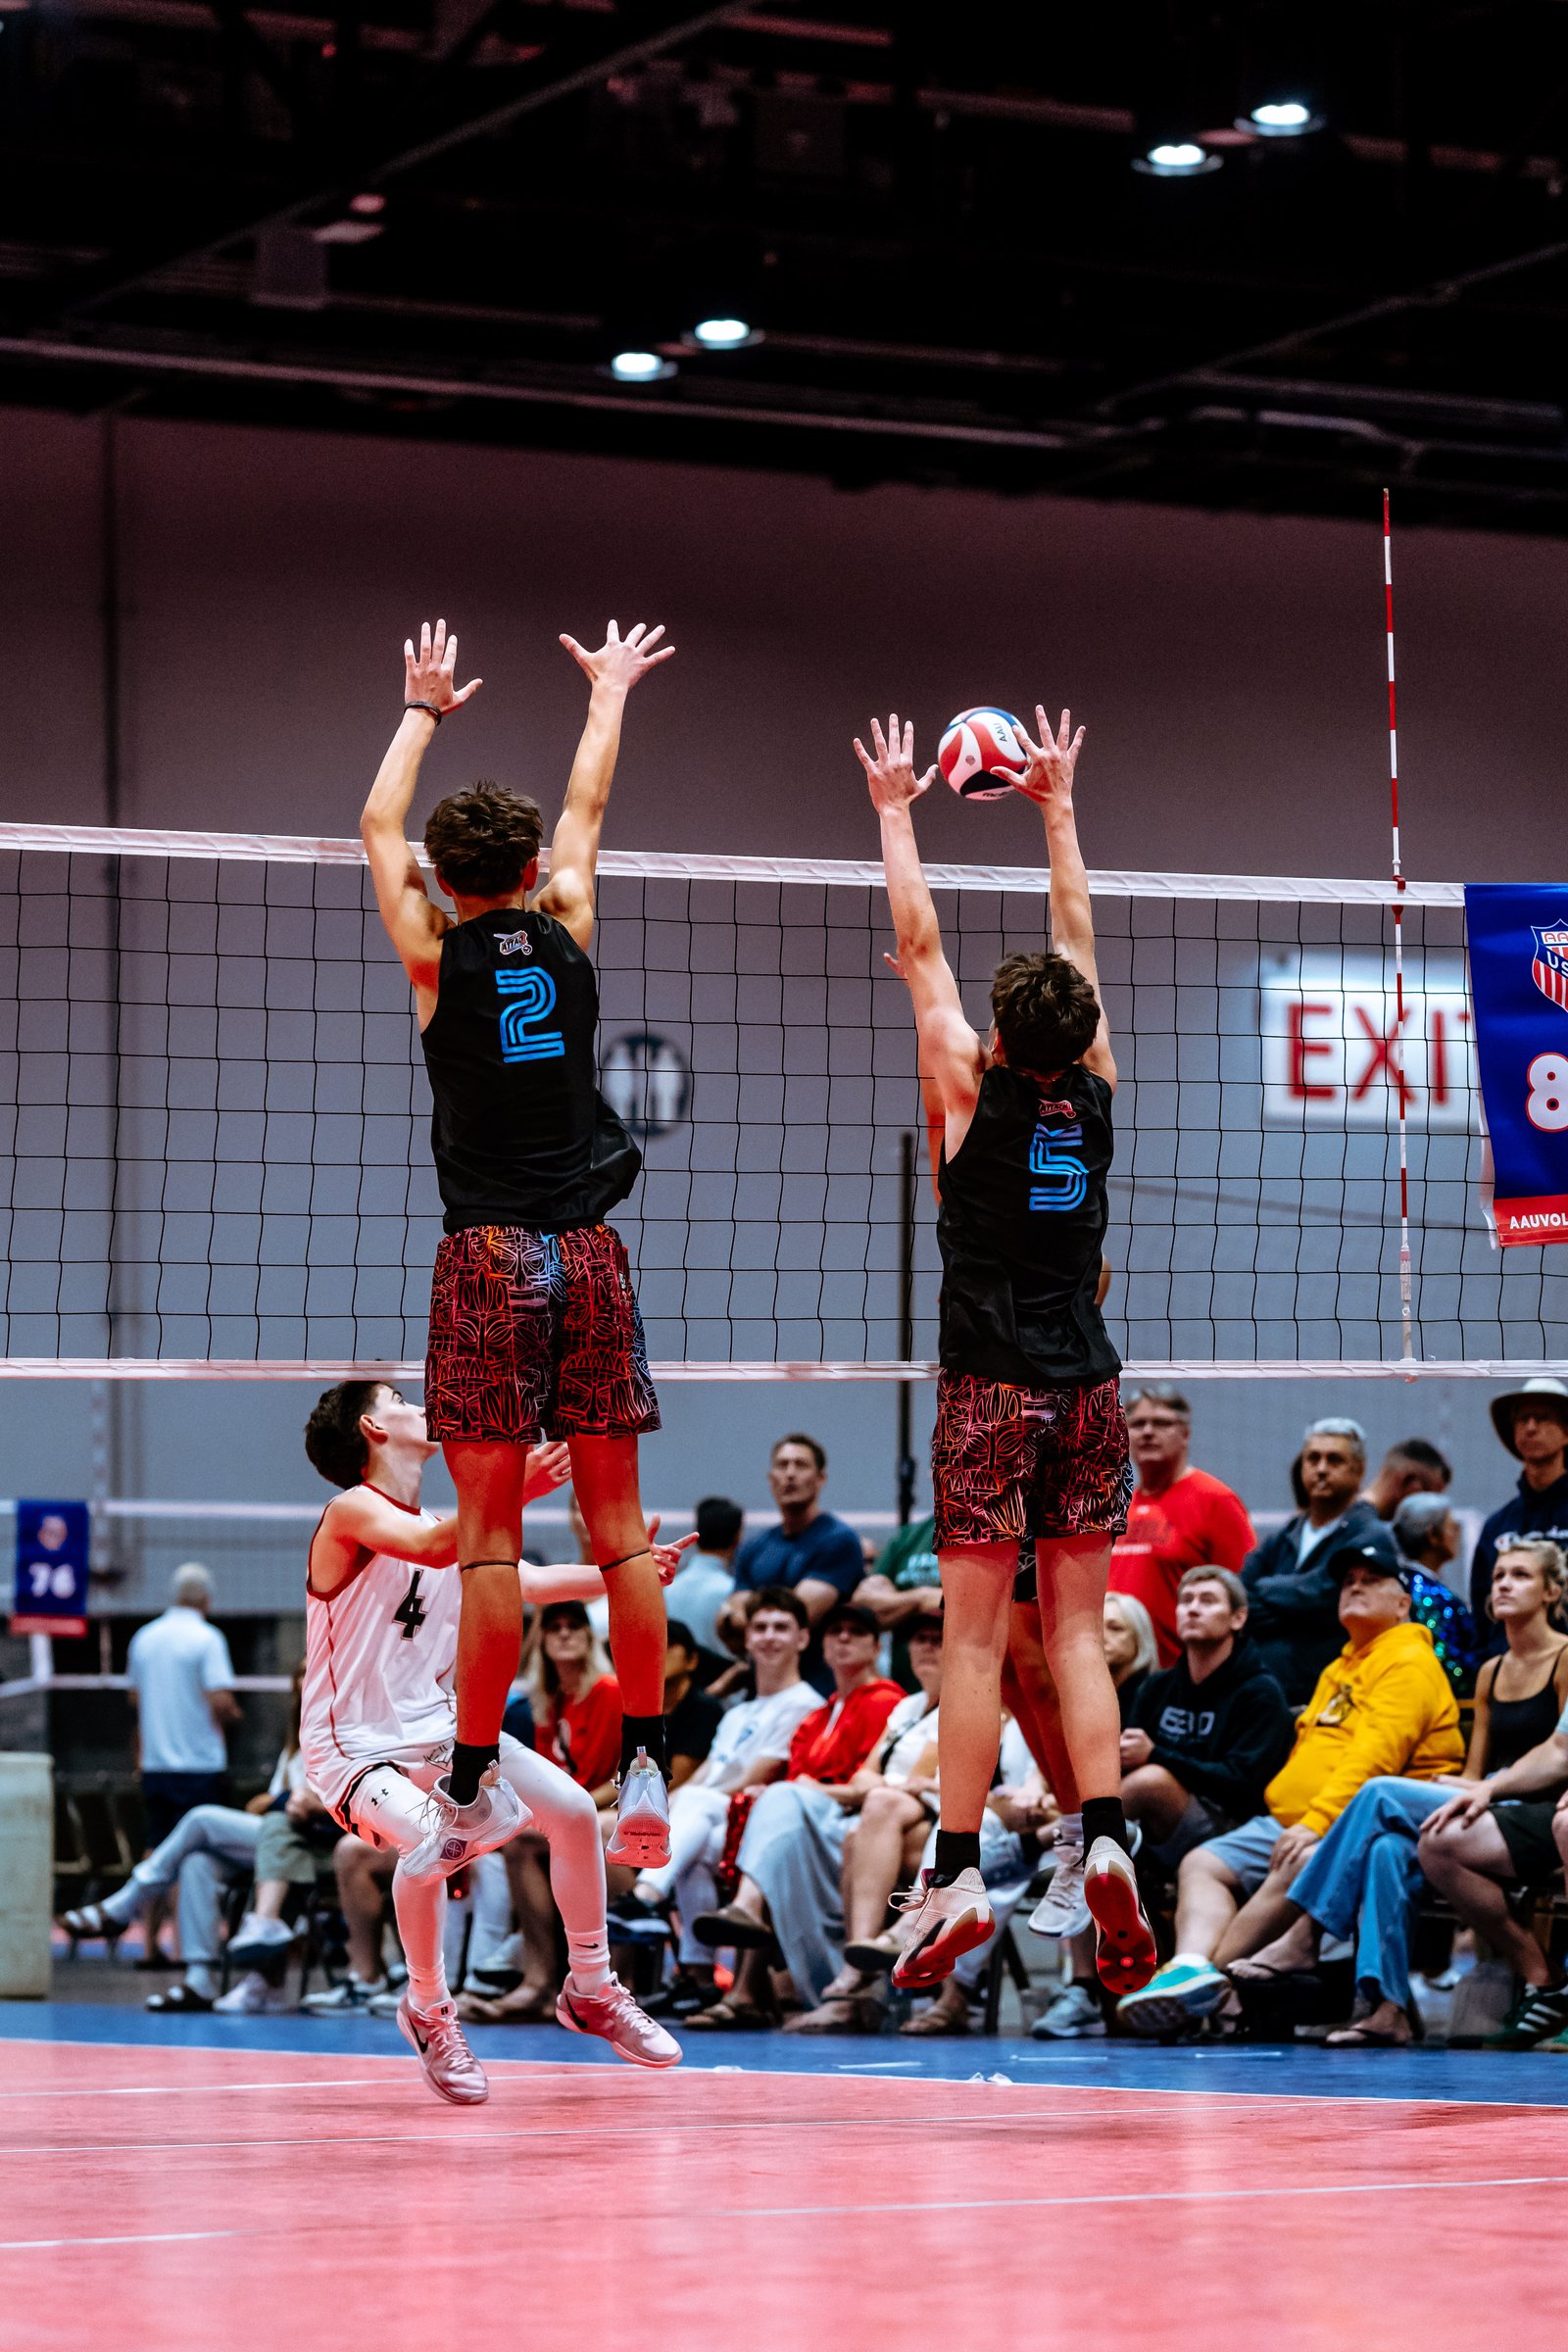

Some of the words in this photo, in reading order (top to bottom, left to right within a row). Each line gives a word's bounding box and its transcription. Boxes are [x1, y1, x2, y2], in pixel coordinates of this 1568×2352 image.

[495, 965, 565, 1063] 2
[1525, 1052, 1568, 1133] 8
[1029, 1123, 1089, 1211] 5
[392, 1568, 429, 1642] 4
